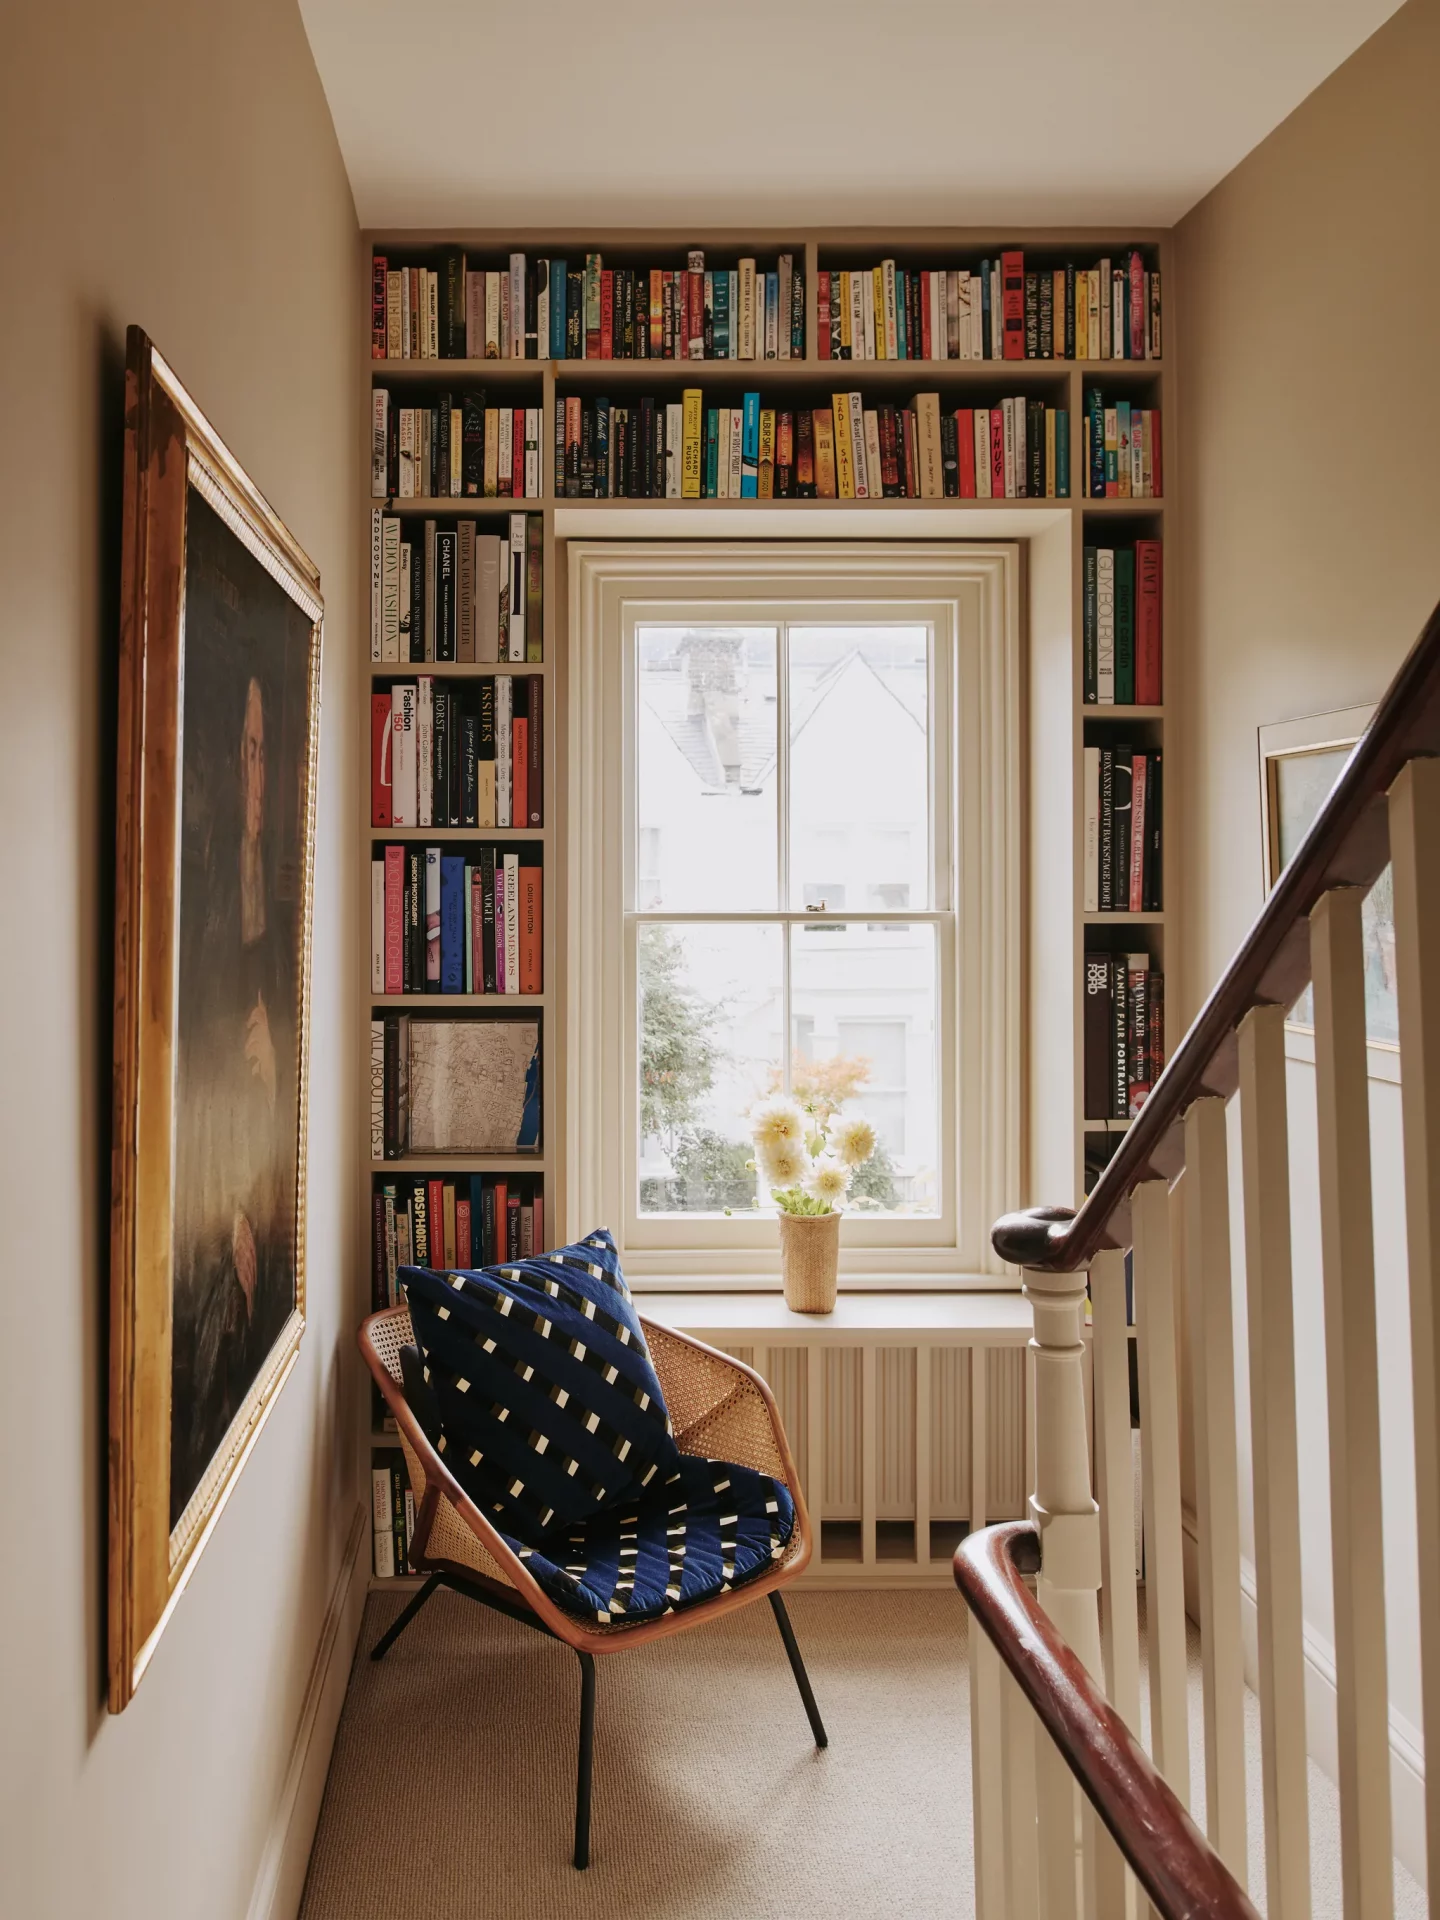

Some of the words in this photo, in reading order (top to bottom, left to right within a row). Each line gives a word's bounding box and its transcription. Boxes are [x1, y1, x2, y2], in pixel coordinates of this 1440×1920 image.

[448, 257, 456, 274] Alan
[448, 277, 456, 306] Bennett
[514, 294, 519, 302] WE
[603, 273, 611, 300] PETER
[603, 302, 611, 334] CAREY
[853, 310, 860, 318] AM
[514, 327, 519, 335] DO
[556, 401, 564, 423] CHIGOZIE
[597, 407, 607, 440] Melmoth
[762, 412, 771, 436] WILBUR
[837, 397, 845, 437] ZADIE
[374, 428, 384, 456] TRAITOR
[556, 424, 564, 445] OBIOMA
[732, 439, 740, 454] ROSIE
[762, 437, 771, 456] SMITH
[732, 456, 740, 475] PROJECT
[993, 426, 1002, 476] THUG
[840, 449, 849, 489] SMITH
[385, 524, 398, 573] AVEDON
[442, 538, 450, 580] CHANEL
[461, 524, 470, 564] PATRICK
[483, 559, 497, 591] Dior
[1098, 555, 1113, 591] GUY
[385, 583, 398, 644] FASHION
[461, 568, 470, 644] DEMARCHELIER
[1119, 584, 1132, 624] pierre
[1098, 593, 1113, 662] BOURDIN
[1119, 627, 1132, 668] cardin
[394, 712, 403, 731] 150
[403, 689, 413, 731] Fashion
[436, 694, 445, 732] HORST
[482, 685, 492, 743] ISSUES
[1102, 751, 1111, 796] ROXANNE
[1102, 798, 1111, 827] LOWIT
[1135, 785, 1143, 836] OBSESSIVE
[1102, 829, 1111, 879] BACKSTAGE
[1134, 840, 1142, 885] CREATIVE
[388, 860, 400, 913] MOTHER
[483, 854, 493, 893] UNSEEN
[474, 890, 482, 914] vintage
[1102, 882, 1111, 902] DIOR
[483, 893, 493, 924] VOGUE
[388, 916, 400, 943] AND
[474, 915, 482, 937] fashion
[388, 946, 400, 984] CHILD
[1087, 963, 1097, 995] FORD
[1097, 963, 1107, 989] TOM
[1135, 970, 1145, 992] TIM
[1117, 967, 1125, 1009] VANITY
[1117, 1013, 1125, 1038] FAIR
[1135, 993, 1145, 1037] WALKER
[371, 1030, 383, 1054] ALL
[371, 1058, 383, 1103] ABOUT
[1117, 1043, 1125, 1104] PORTRAITS
[371, 1108, 383, 1144] YVES
[414, 1188, 427, 1258] BOSPHORUS
[523, 1216, 531, 1232] Wild
[523, 1234, 531, 1250] Food
